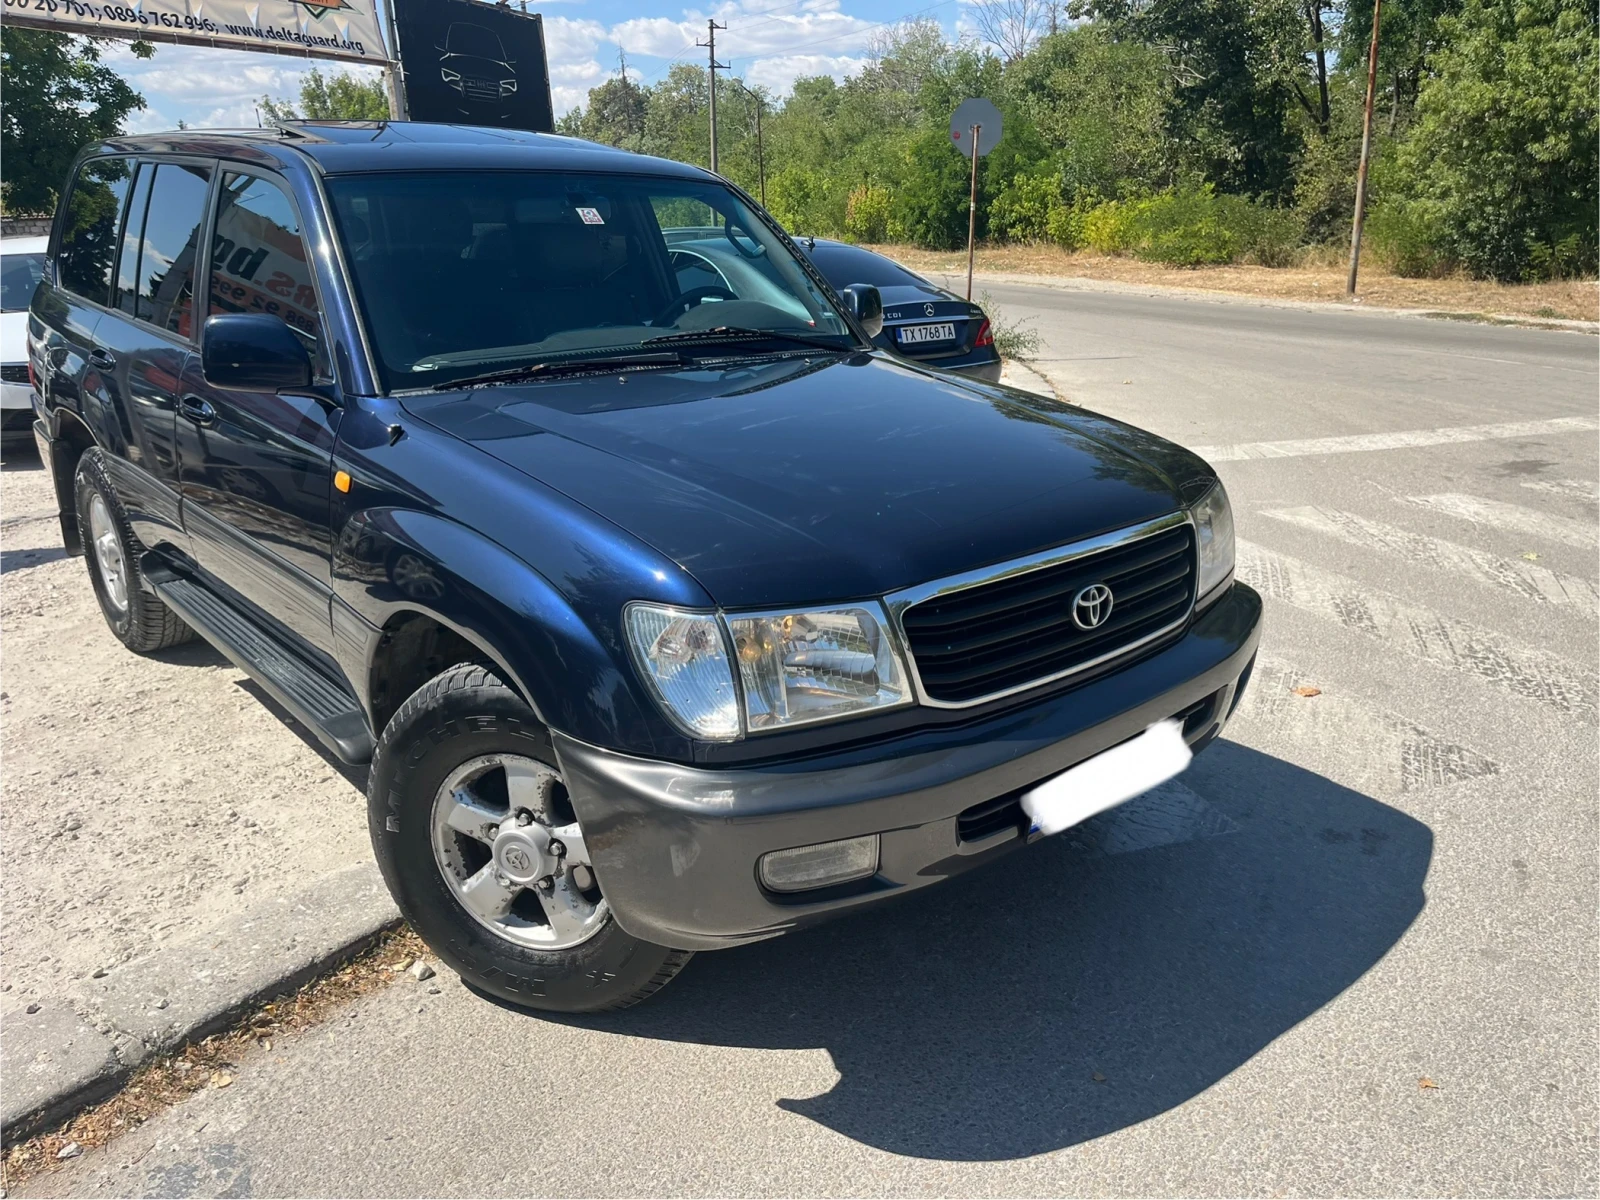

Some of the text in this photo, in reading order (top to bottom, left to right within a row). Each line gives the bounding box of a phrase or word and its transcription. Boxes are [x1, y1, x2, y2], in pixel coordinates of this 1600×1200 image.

[34, 0, 58, 12] 20
[148, 11, 183, 28] 762
[225, 24, 366, 55] www.deltaguard.org
[902, 325, 954, 342] TX 1768 TA
